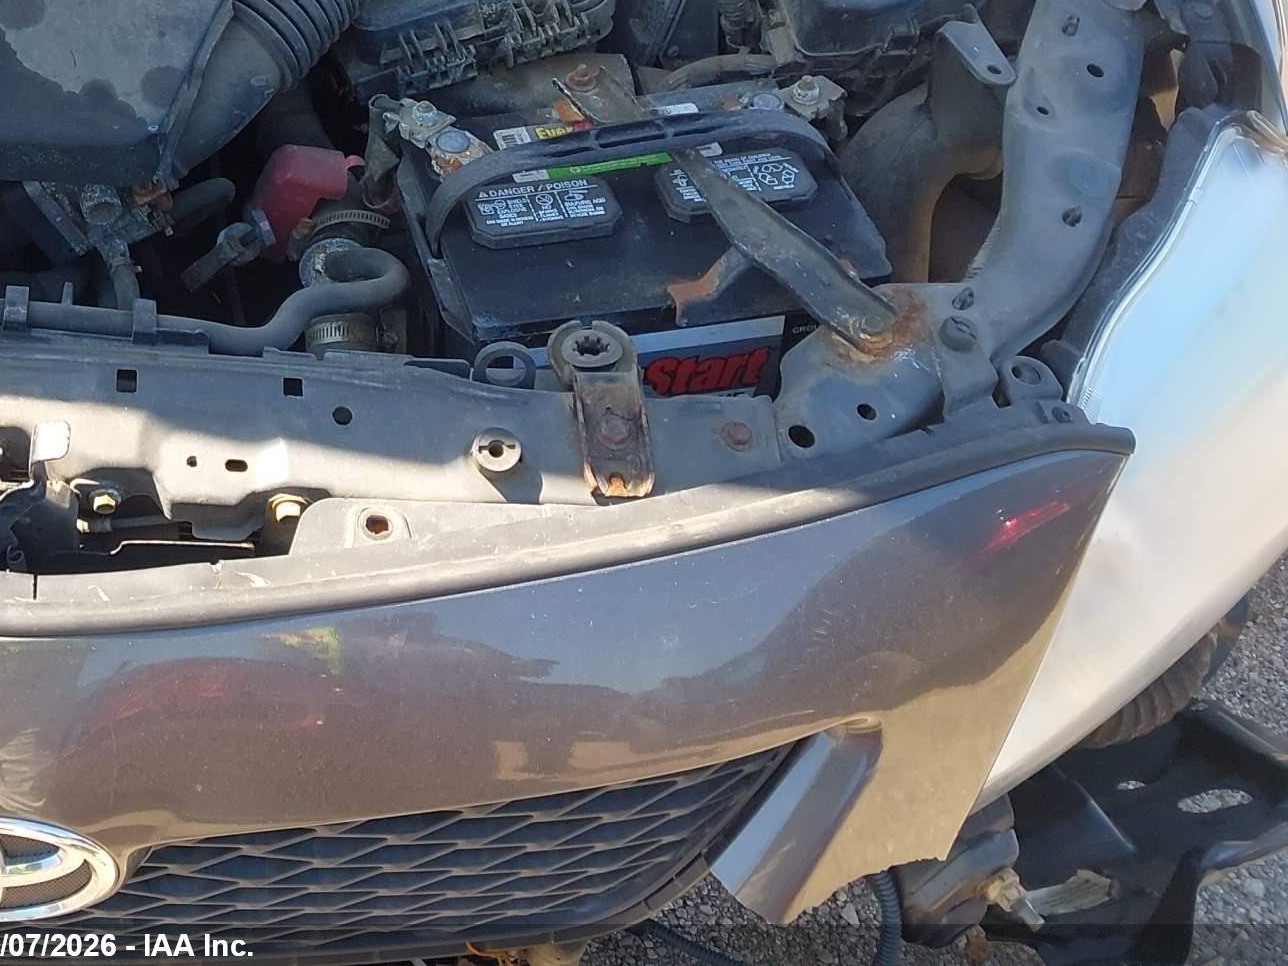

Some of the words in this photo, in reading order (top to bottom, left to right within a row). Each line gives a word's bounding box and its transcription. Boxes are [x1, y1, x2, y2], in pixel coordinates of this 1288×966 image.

[490, 186, 535, 197] DANGER
[546, 179, 588, 190] POISON
[645, 346, 769, 396] Start
